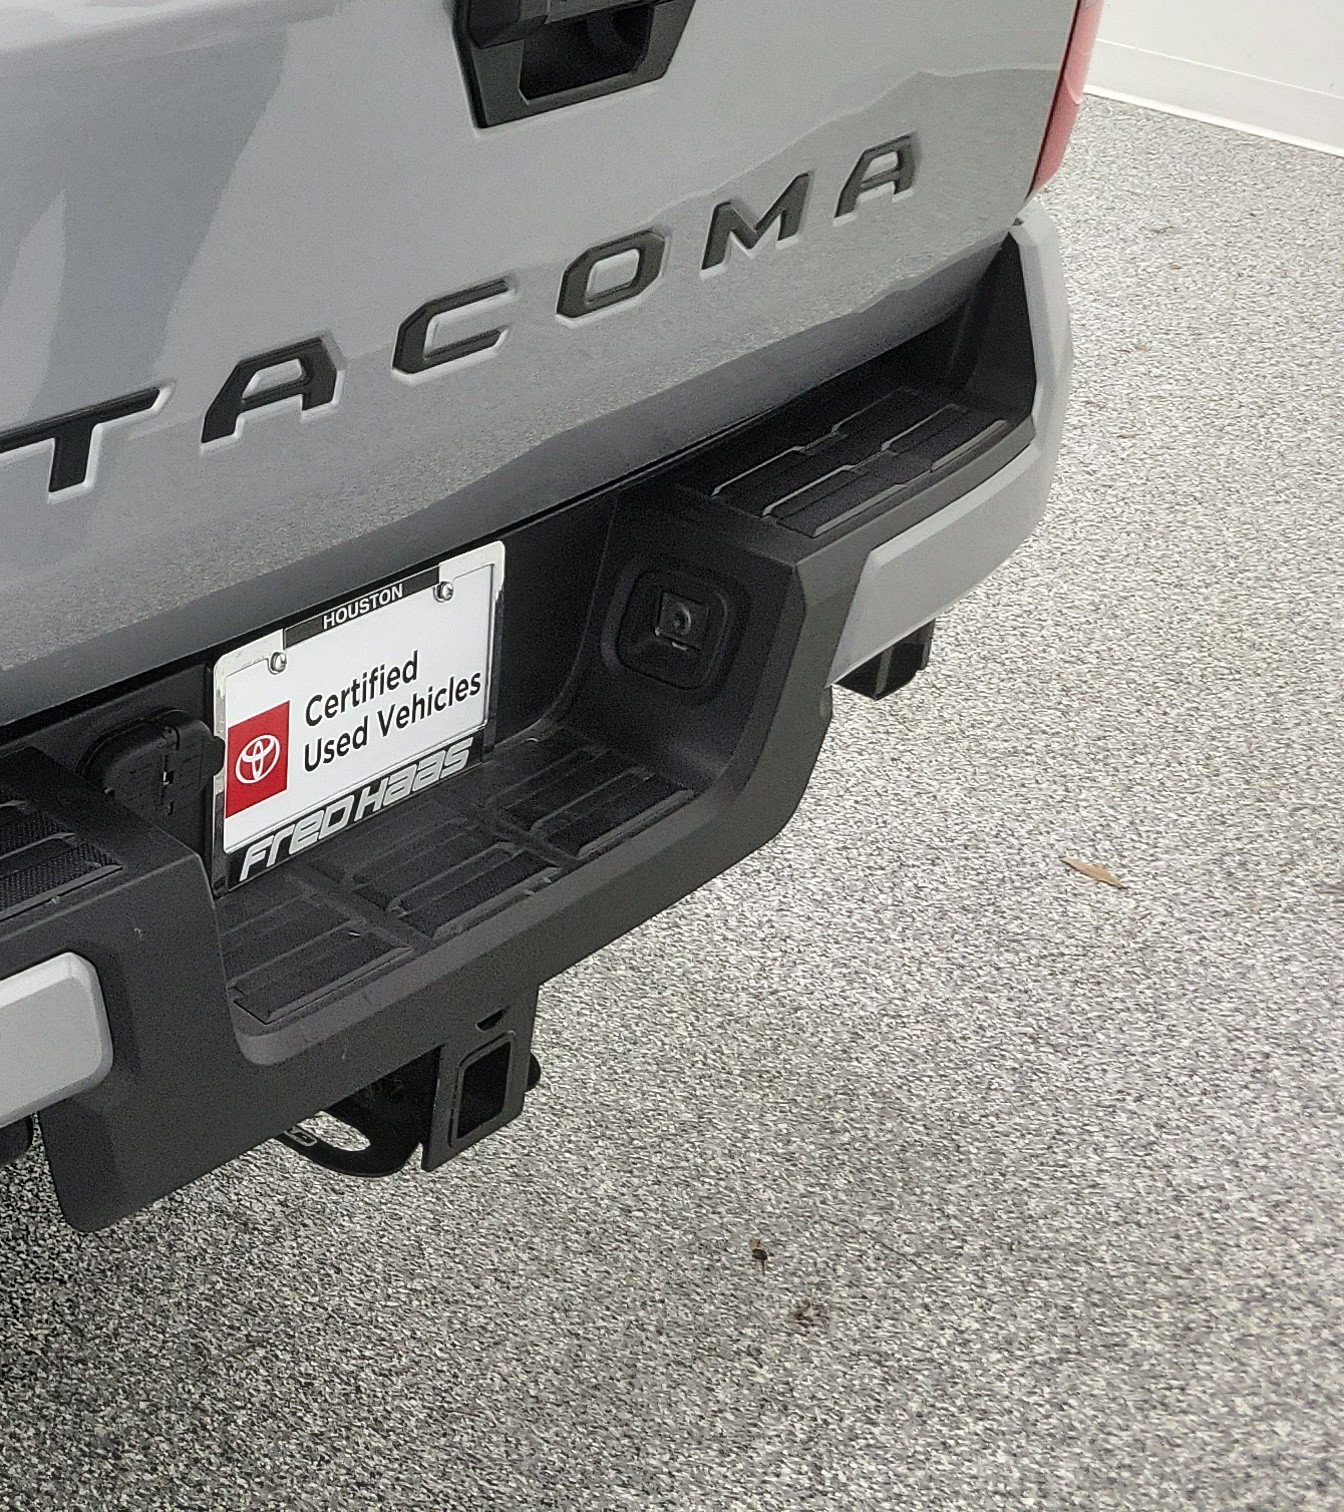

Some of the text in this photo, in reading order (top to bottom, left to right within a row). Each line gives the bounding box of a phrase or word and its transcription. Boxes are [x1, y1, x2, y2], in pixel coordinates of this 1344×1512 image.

[323, 584, 404, 630] HOUSTON
[303, 671, 482, 772] Used Vehicles
[305, 650, 419, 726] Certified
